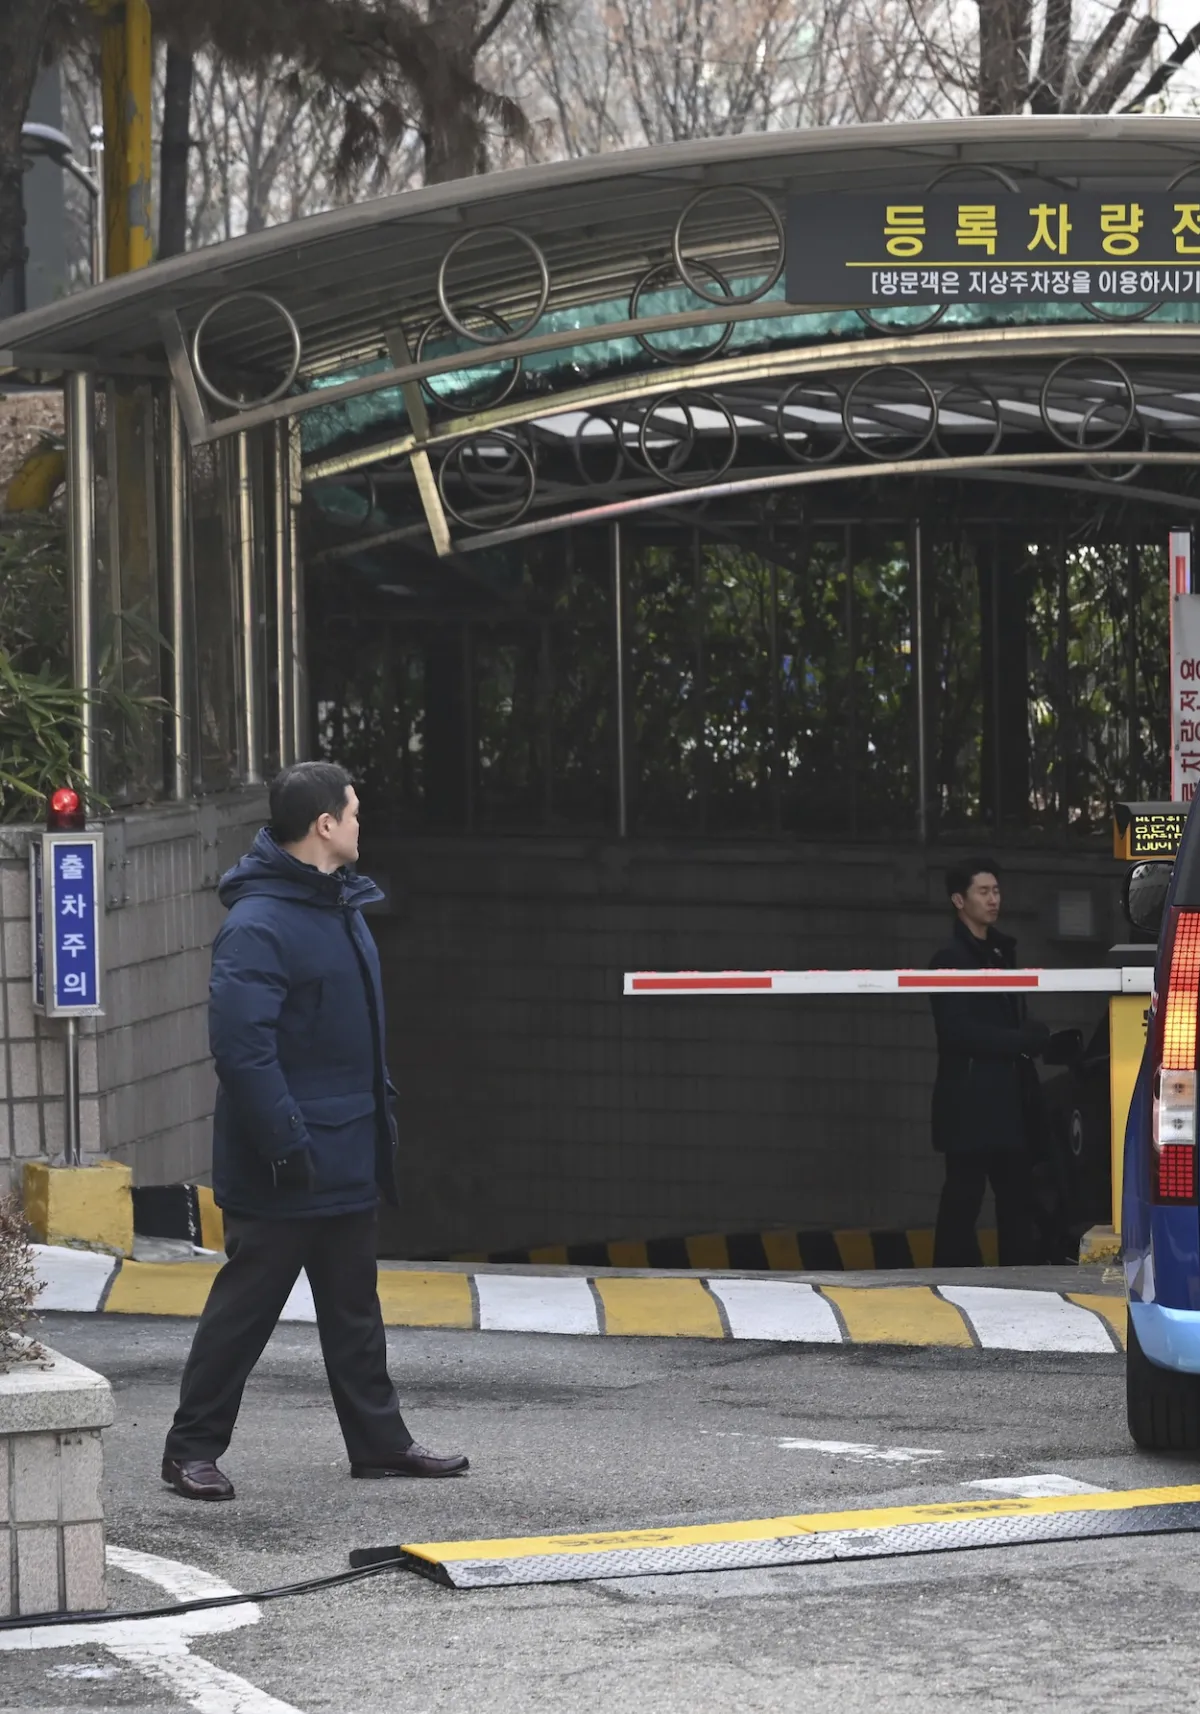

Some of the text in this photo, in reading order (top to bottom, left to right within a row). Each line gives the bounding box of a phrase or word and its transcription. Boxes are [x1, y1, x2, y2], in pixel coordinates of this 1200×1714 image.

[871, 271, 960, 295] [방문객은
[968, 271, 1091, 295] 지상주차장을
[60, 854, 87, 996] 출차주의
